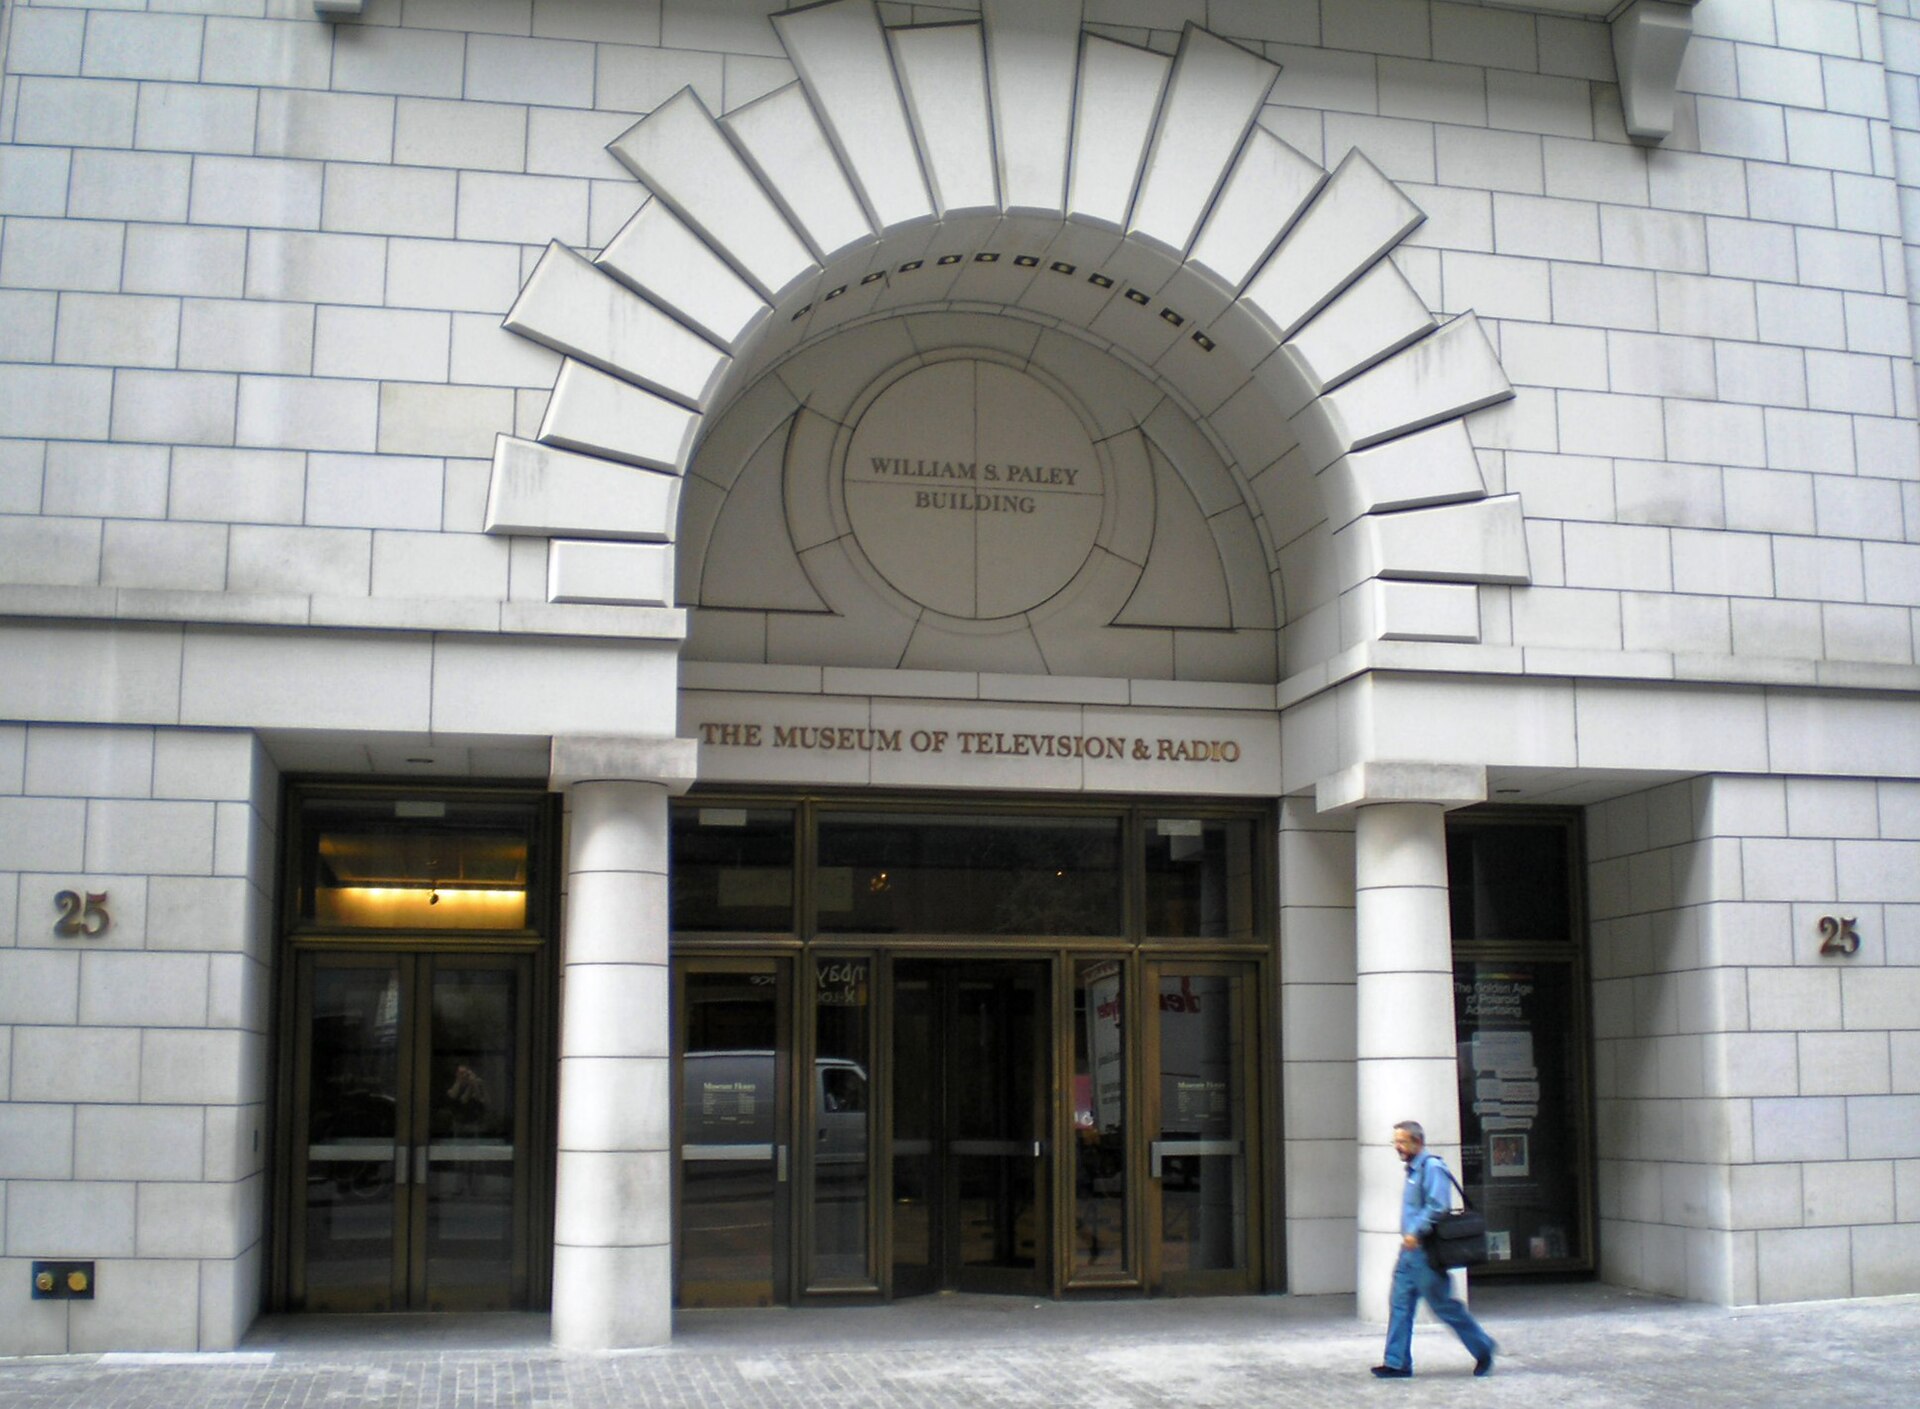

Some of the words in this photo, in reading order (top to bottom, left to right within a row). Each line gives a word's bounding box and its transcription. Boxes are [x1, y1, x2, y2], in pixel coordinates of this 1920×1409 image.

[870, 457, 977, 480] WILLIAM
[984, 464, 1001, 481] S.
[1006, 464, 1079, 486] PALEY
[915, 491, 1036, 513] BUILDING
[700, 723, 762, 747] THE
[772, 726, 902, 752] MUSEUM
[910, 730, 949, 752] OF
[957, 733, 1126, 761] TELEVISION
[1131, 738, 1152, 761] &
[1157, 739, 1241, 763] RADIO
[53, 889, 110, 939] 25
[1818, 915, 1861, 958] 25
